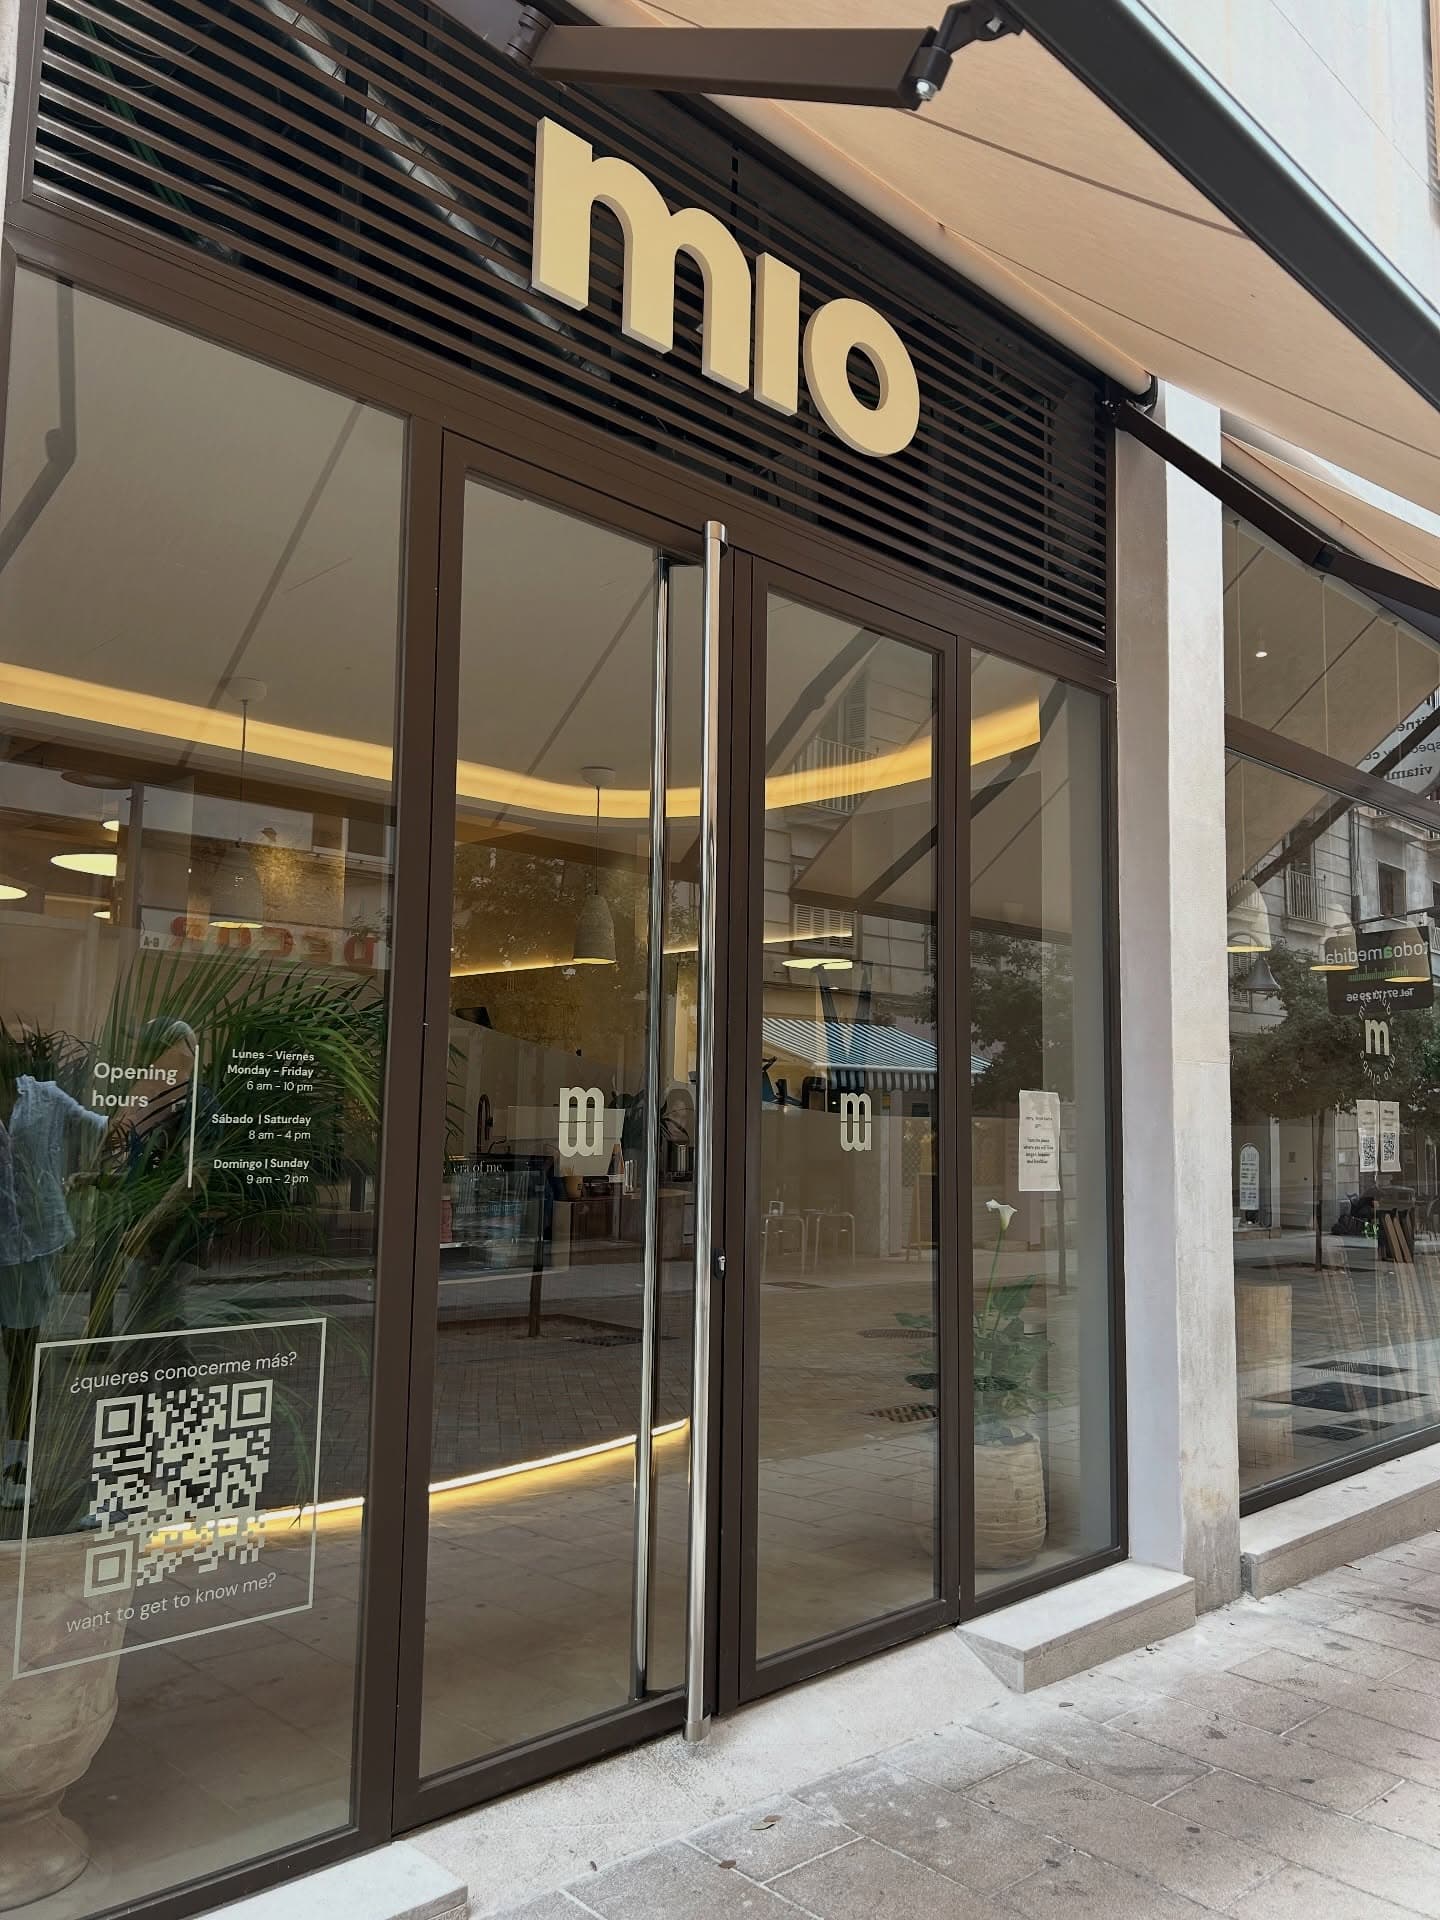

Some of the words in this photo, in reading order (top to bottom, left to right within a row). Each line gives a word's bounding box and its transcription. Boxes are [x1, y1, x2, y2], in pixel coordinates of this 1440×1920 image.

[532, 116, 920, 457] mio
[232, 1048, 265, 1060] Lunes
[275, 1050, 315, 1061] Viernes
[94, 1062, 178, 1085] Opening
[227, 1064, 271, 1078] Monday
[281, 1066, 314, 1079] Friday
[246, 1080, 254, 1090] 6
[256, 1083, 273, 1091] am
[284, 1081, 295, 1091] 10
[296, 1084, 313, 1094] pm
[92, 1089, 148, 1107] hours
[211, 1113, 254, 1124] Sábado
[264, 1114, 311, 1127] Saturday
[248, 1130, 256, 1140] 8
[258, 1132, 274, 1140] am
[284, 1130, 292, 1140] 4
[294, 1132, 311, 1142] pm
[213, 1159, 262, 1171] Domingo
[270, 1158, 310, 1170] Sunday
[472, 1160, 486, 1174] of
[246, 1174, 254, 1184] 9
[256, 1176, 273, 1184] am
[283, 1174, 291, 1184] 2
[291, 1175, 309, 1186] pm
[70, 1370, 149, 1394] ¿quieres
[154, 1358, 251, 1382] conocerme
[255, 1351, 297, 1371] más?
[66, 1610, 112, 1633] want
[117, 1606, 135, 1621] to
[140, 1598, 168, 1620] get
[173, 1594, 191, 1609] to
[196, 1583, 239, 1603] know
[243, 1571, 277, 1593] me?
